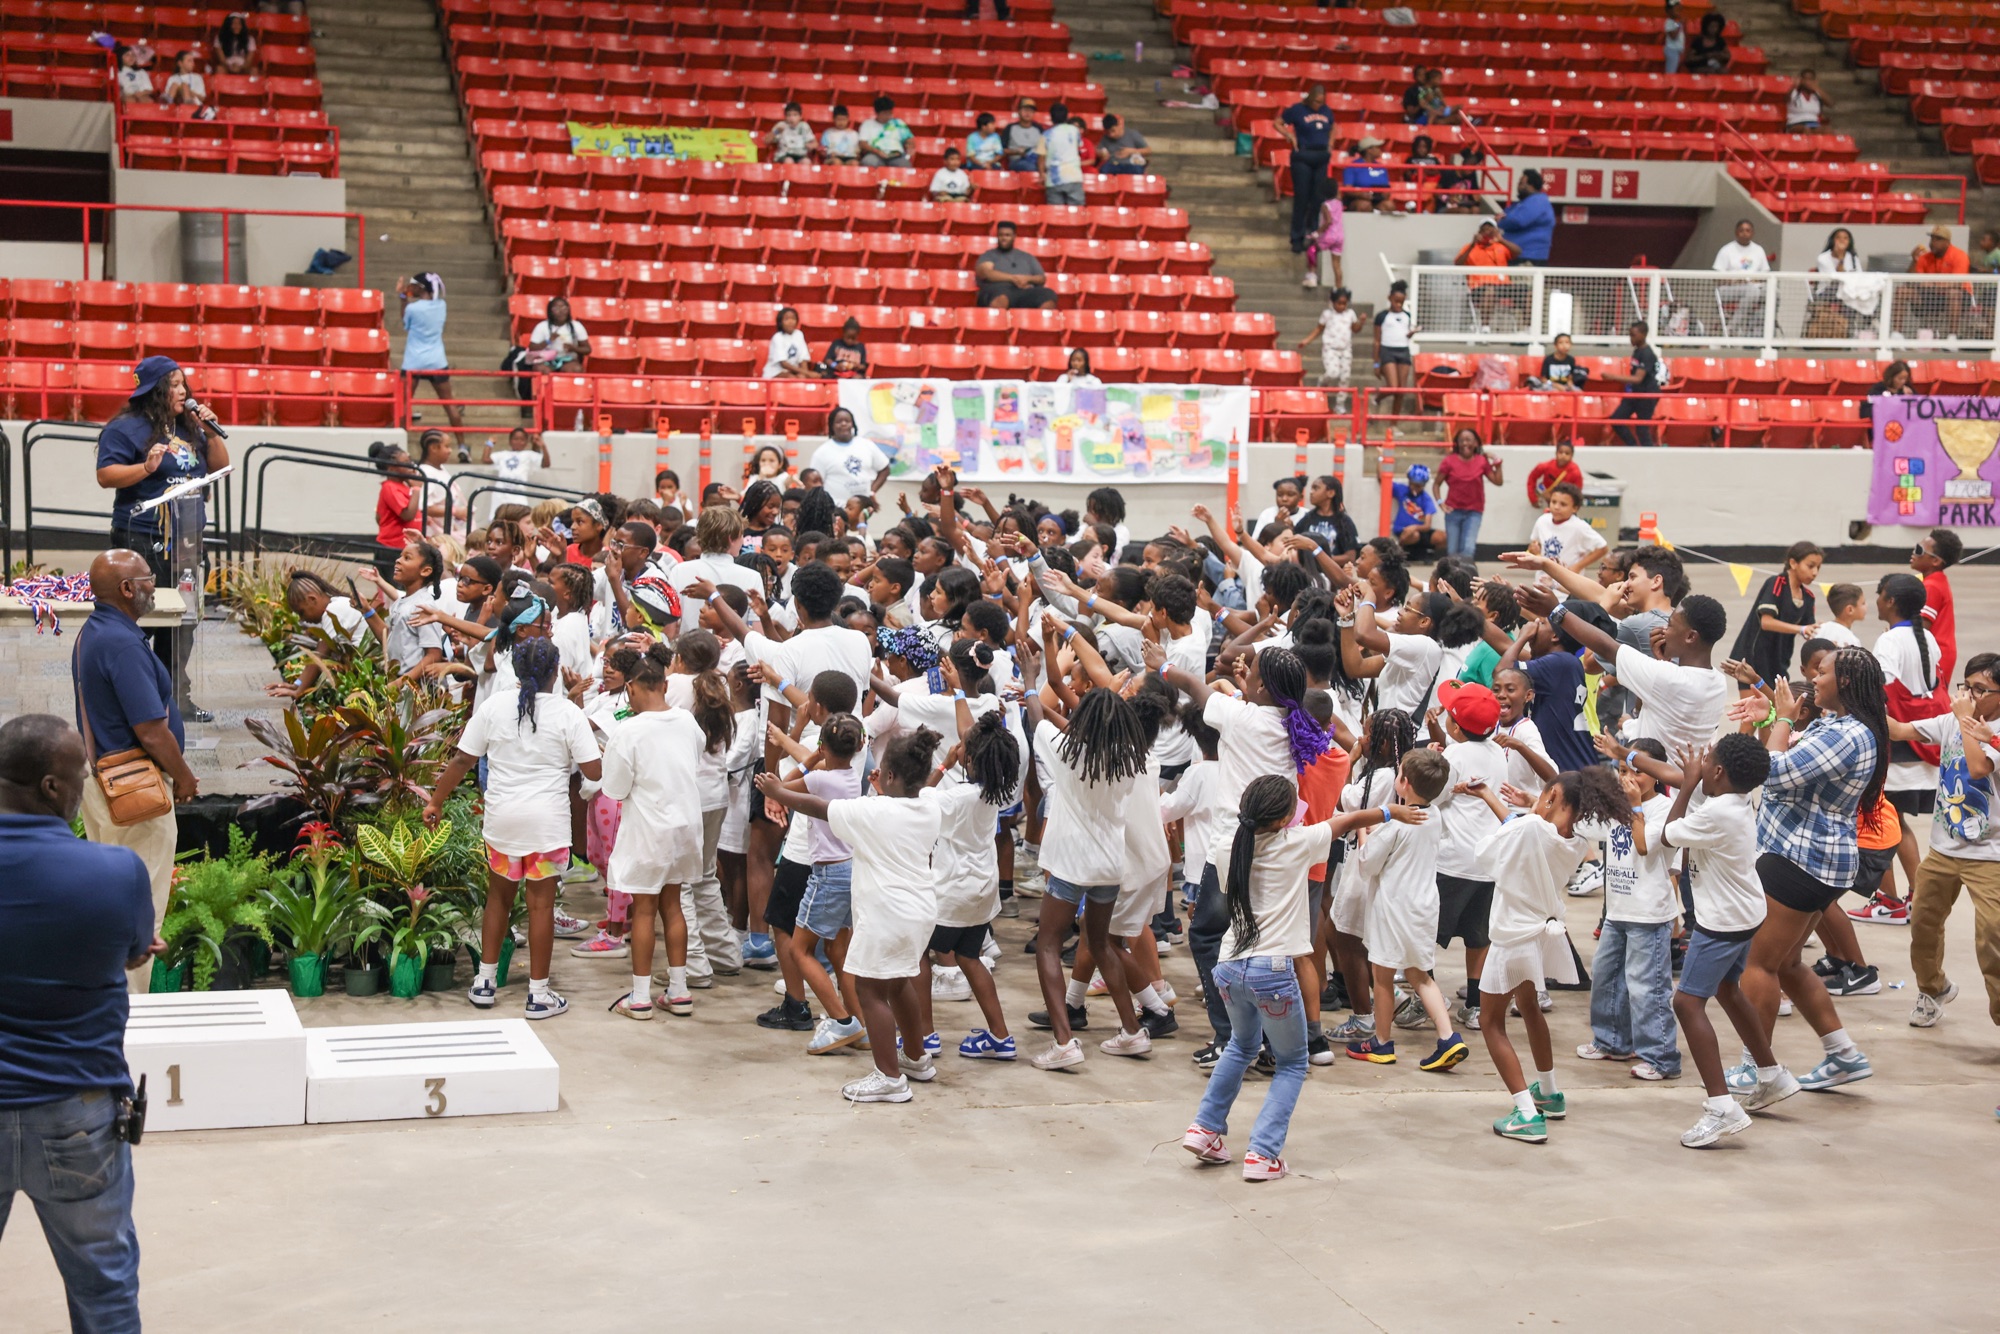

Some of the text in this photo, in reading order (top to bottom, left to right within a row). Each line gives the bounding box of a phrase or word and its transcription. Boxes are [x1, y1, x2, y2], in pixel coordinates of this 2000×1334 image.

[1579, 175, 1593, 184] 102
[1614, 176, 1629, 185] 103
[1939, 503, 1995, 525] PARK
[166, 1064, 184, 1106] 1
[424, 1077, 447, 1116] 3
